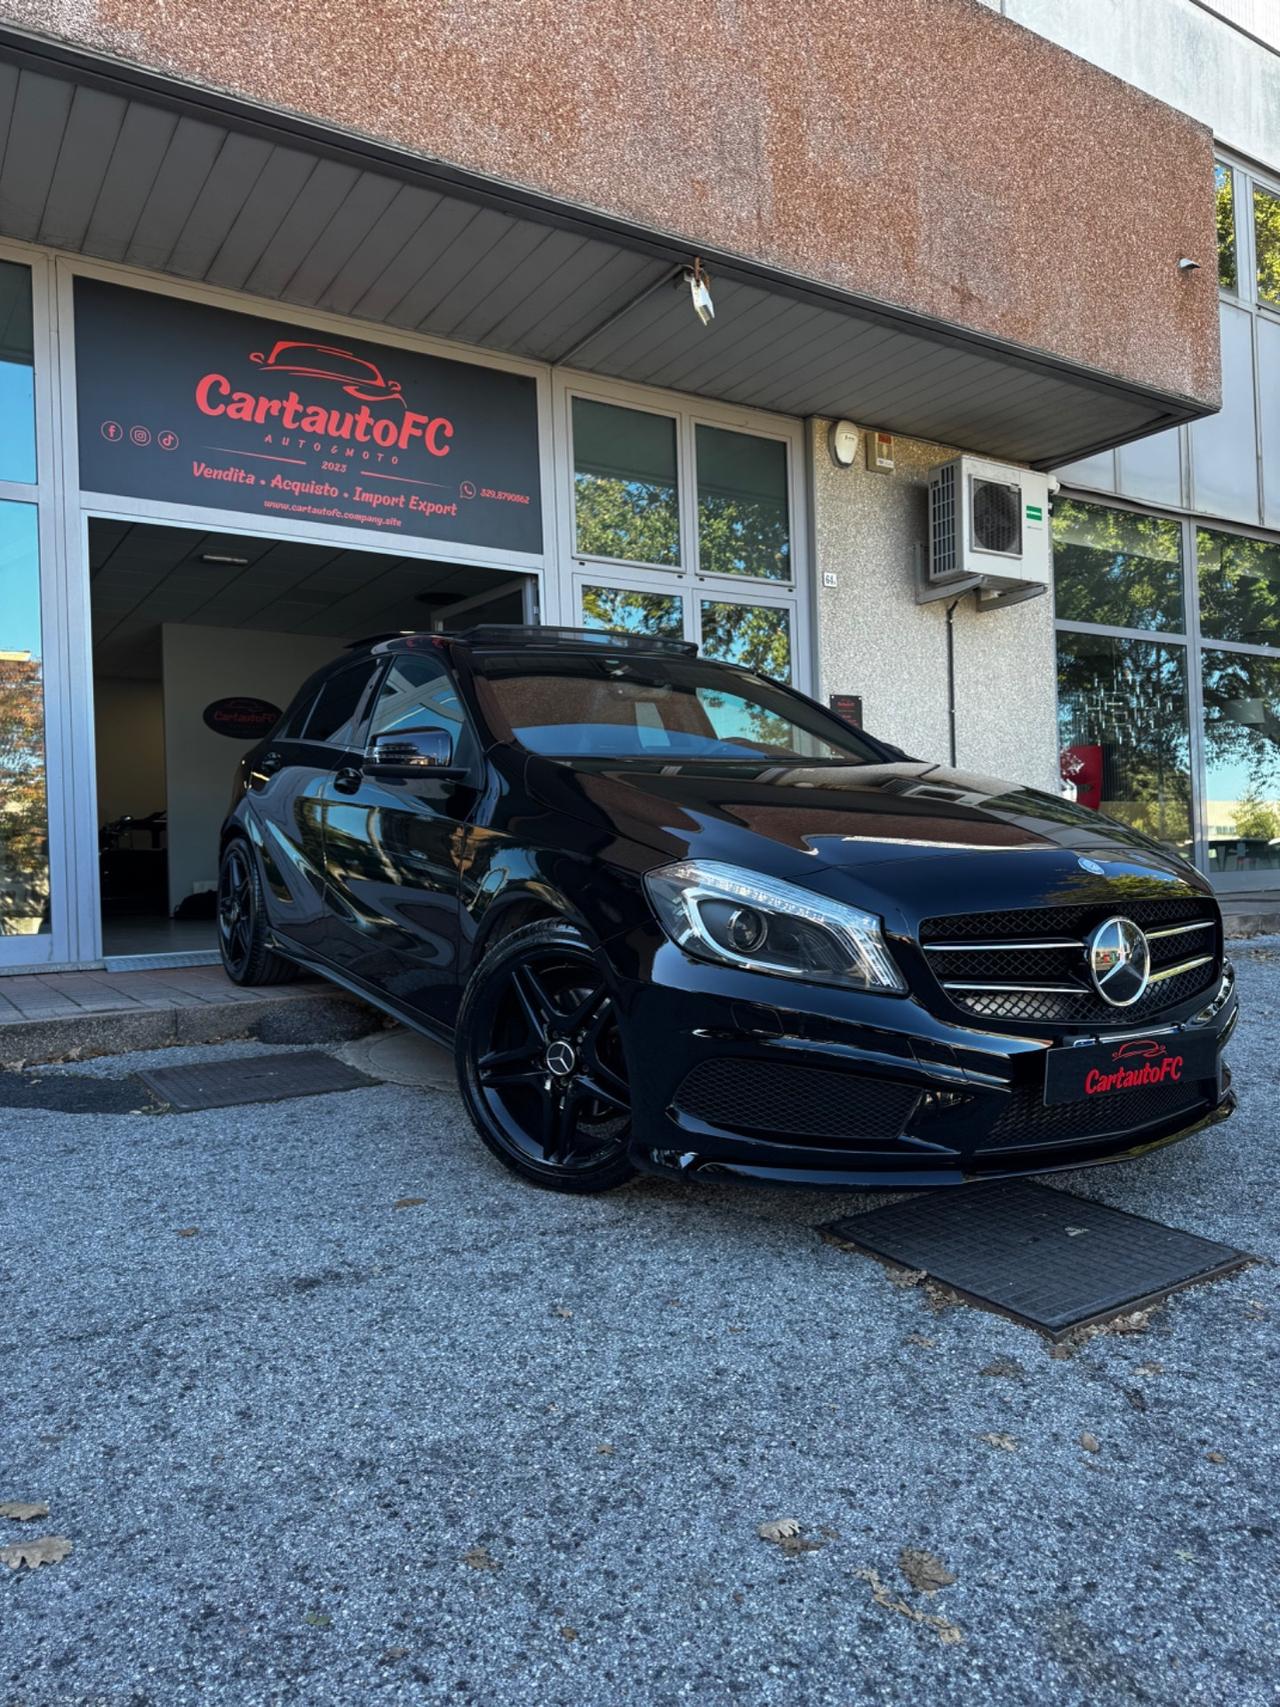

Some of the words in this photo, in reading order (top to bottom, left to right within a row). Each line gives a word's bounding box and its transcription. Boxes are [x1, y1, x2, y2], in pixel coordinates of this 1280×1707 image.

[195, 373, 454, 457] CartautoFC
[321, 460, 348, 474] 2023
[192, 461, 256, 486] Vendita
[270, 474, 339, 498] Acquisto
[353, 486, 404, 508] Import
[408, 496, 458, 517] Export
[264, 499, 402, 527] www.cartautofc.company.site
[1084, 1055, 1183, 1095] CartautoFC
